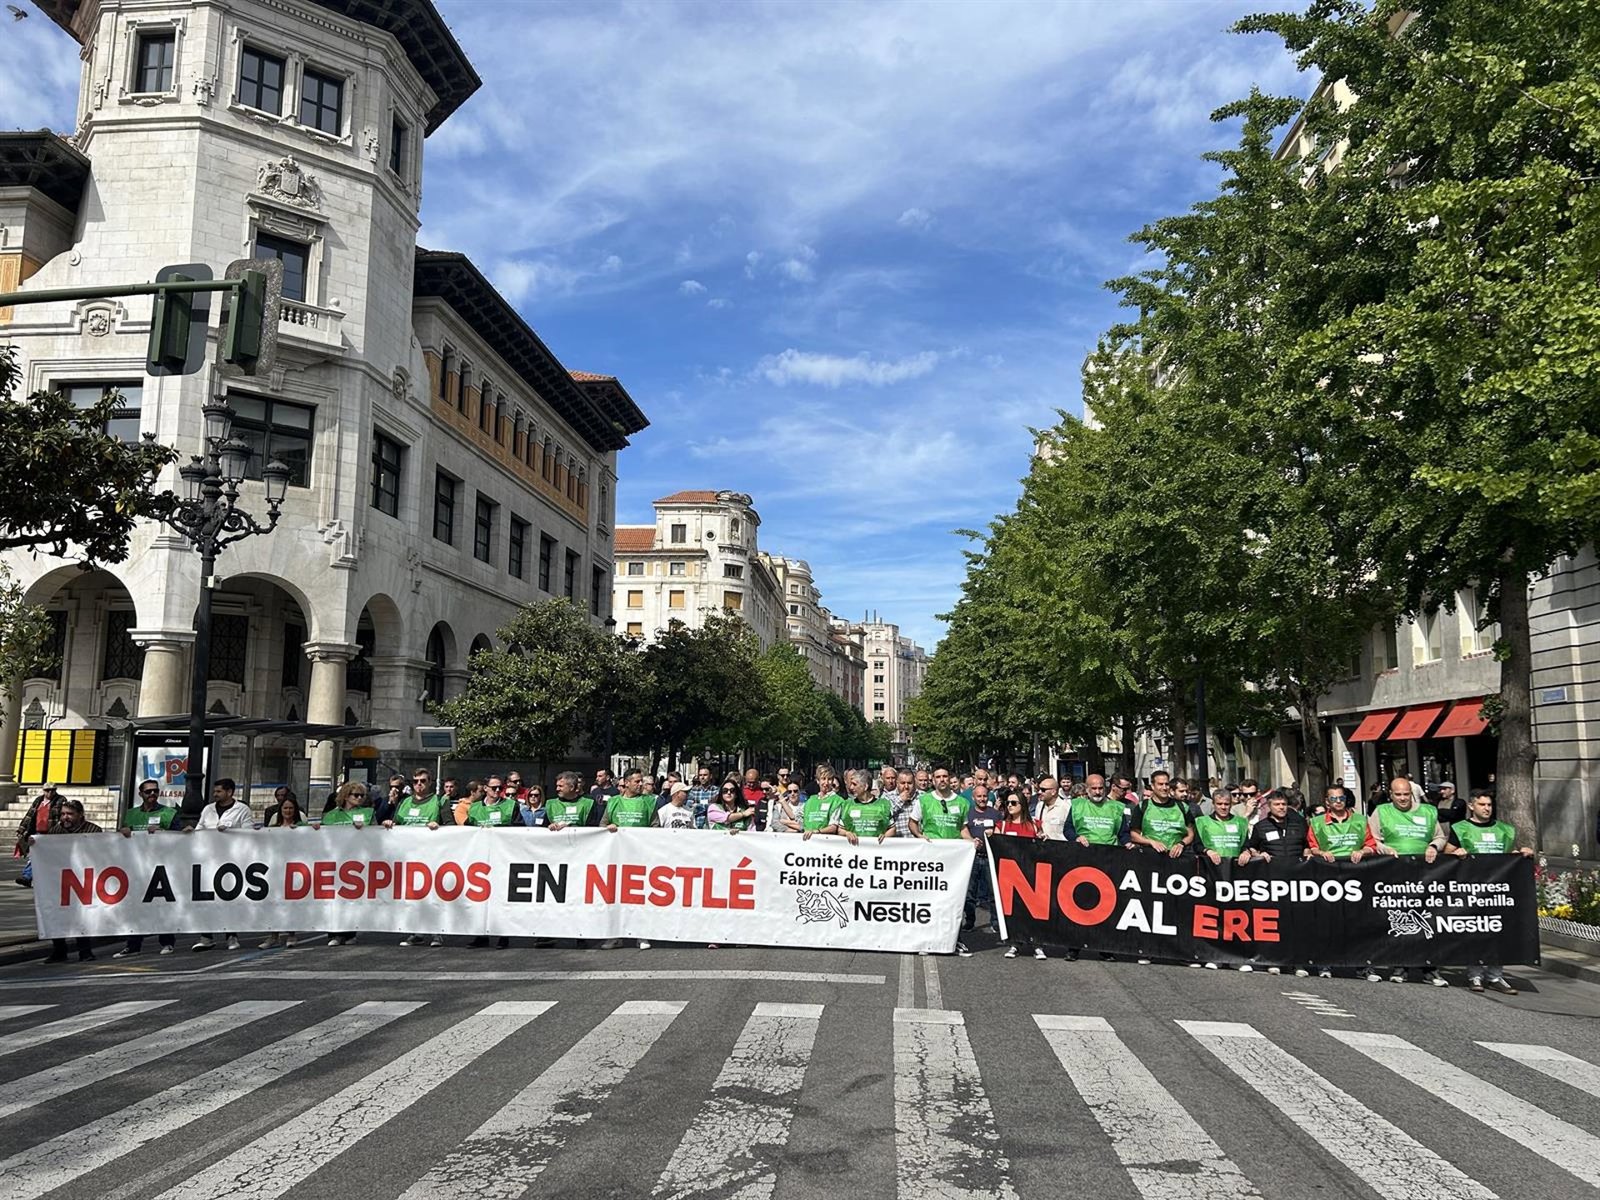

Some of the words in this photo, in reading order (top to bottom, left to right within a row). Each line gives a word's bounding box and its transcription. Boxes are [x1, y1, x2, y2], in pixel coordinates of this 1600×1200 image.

[784, 852, 843, 868] Comité
[848, 854, 868, 870] de
[874, 856, 944, 875] Empresa
[61, 867, 129, 906] NO
[143, 865, 177, 904] A
[191, 862, 269, 902] LOS
[284, 860, 492, 903] DESPIDOS
[507, 863, 568, 904] EN
[583, 856, 757, 910] NESTLÉ
[779, 870, 838, 887] Fábrica
[843, 874, 864, 888] de
[869, 875, 887, 889] La
[893, 876, 948, 891] Penilla
[997, 857, 1118, 927] NO
[1118, 869, 1142, 892] A
[1151, 871, 1207, 898] LOS
[1215, 879, 1363, 903] DESPIDOS
[1374, 881, 1425, 893] Comité
[1428, 881, 1445, 893] de
[1449, 881, 1510, 895] Empresa
[1372, 895, 1422, 908] Fábrica
[1425, 895, 1444, 907] de
[1447, 895, 1464, 907] La
[1467, 894, 1515, 907] Penilla
[1115, 898, 1178, 936] AL
[1191, 904, 1281, 943] ERE
